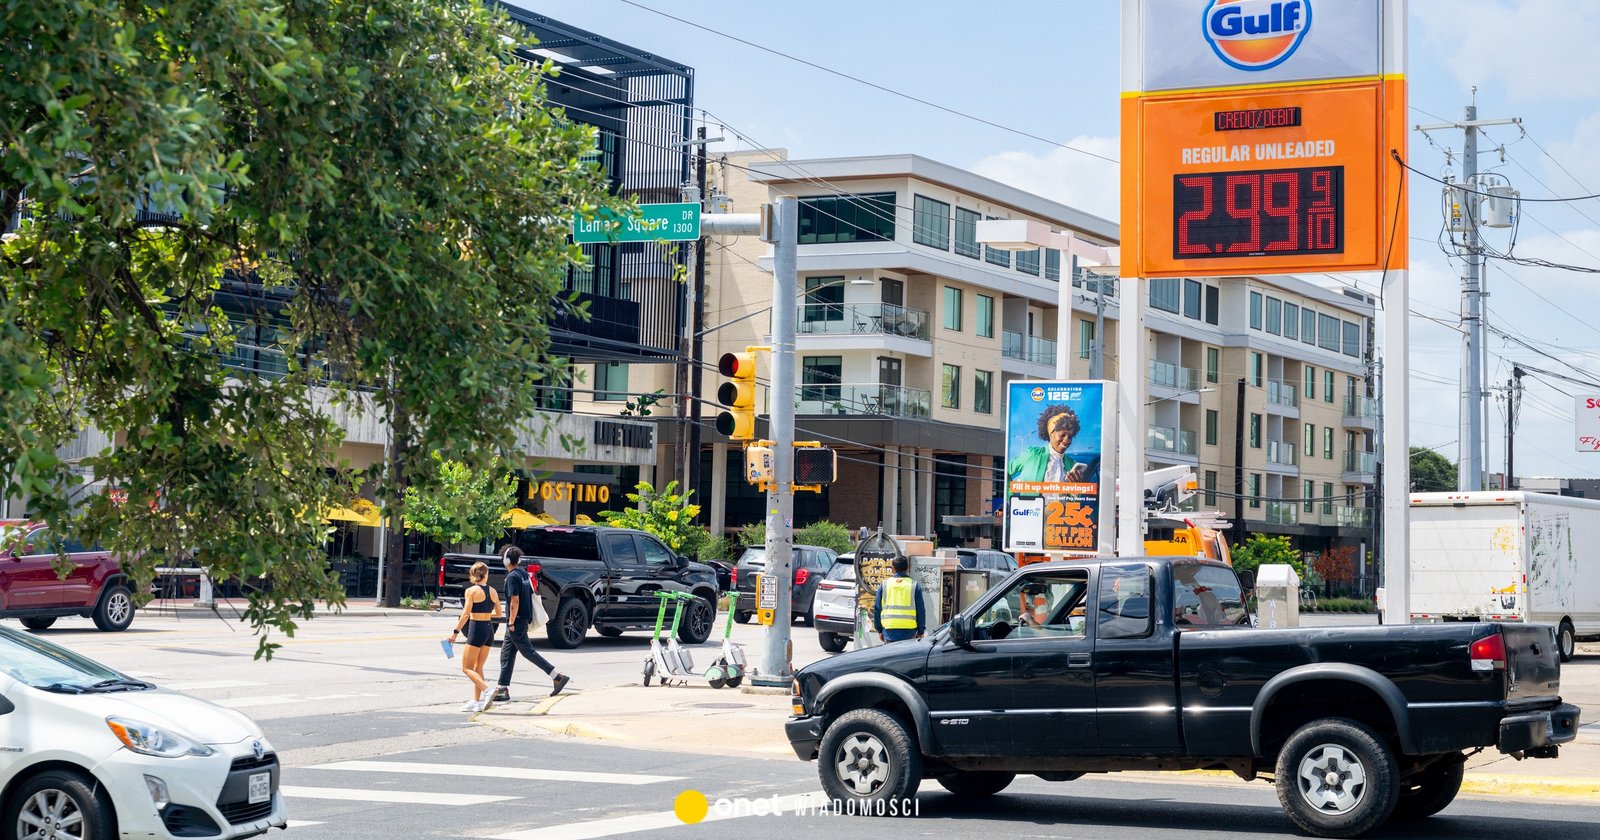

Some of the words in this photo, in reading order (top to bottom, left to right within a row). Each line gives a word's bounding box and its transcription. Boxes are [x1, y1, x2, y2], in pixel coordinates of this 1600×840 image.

[1210, 1, 1300, 36] Gulf
[1218, 108, 1296, 129] CREDIT/DEBIT
[1182, 144, 1250, 165] REGULAR
[1255, 140, 1335, 161] UNLEADED
[682, 210, 693, 220] DR
[1178, 172, 1299, 255] 2.99
[627, 215, 669, 233] Square
[673, 223, 693, 233] 1300
[1047, 391, 1070, 400] 125
[594, 420, 622, 446] LIFE
[622, 423, 653, 449] TIME
[528, 481, 610, 503] POSTINO
[1062, 485, 1094, 493] savings!
[1046, 526, 1068, 537] OFF
[1071, 527, 1093, 538] PER
[1046, 536, 1093, 547] GALLON
